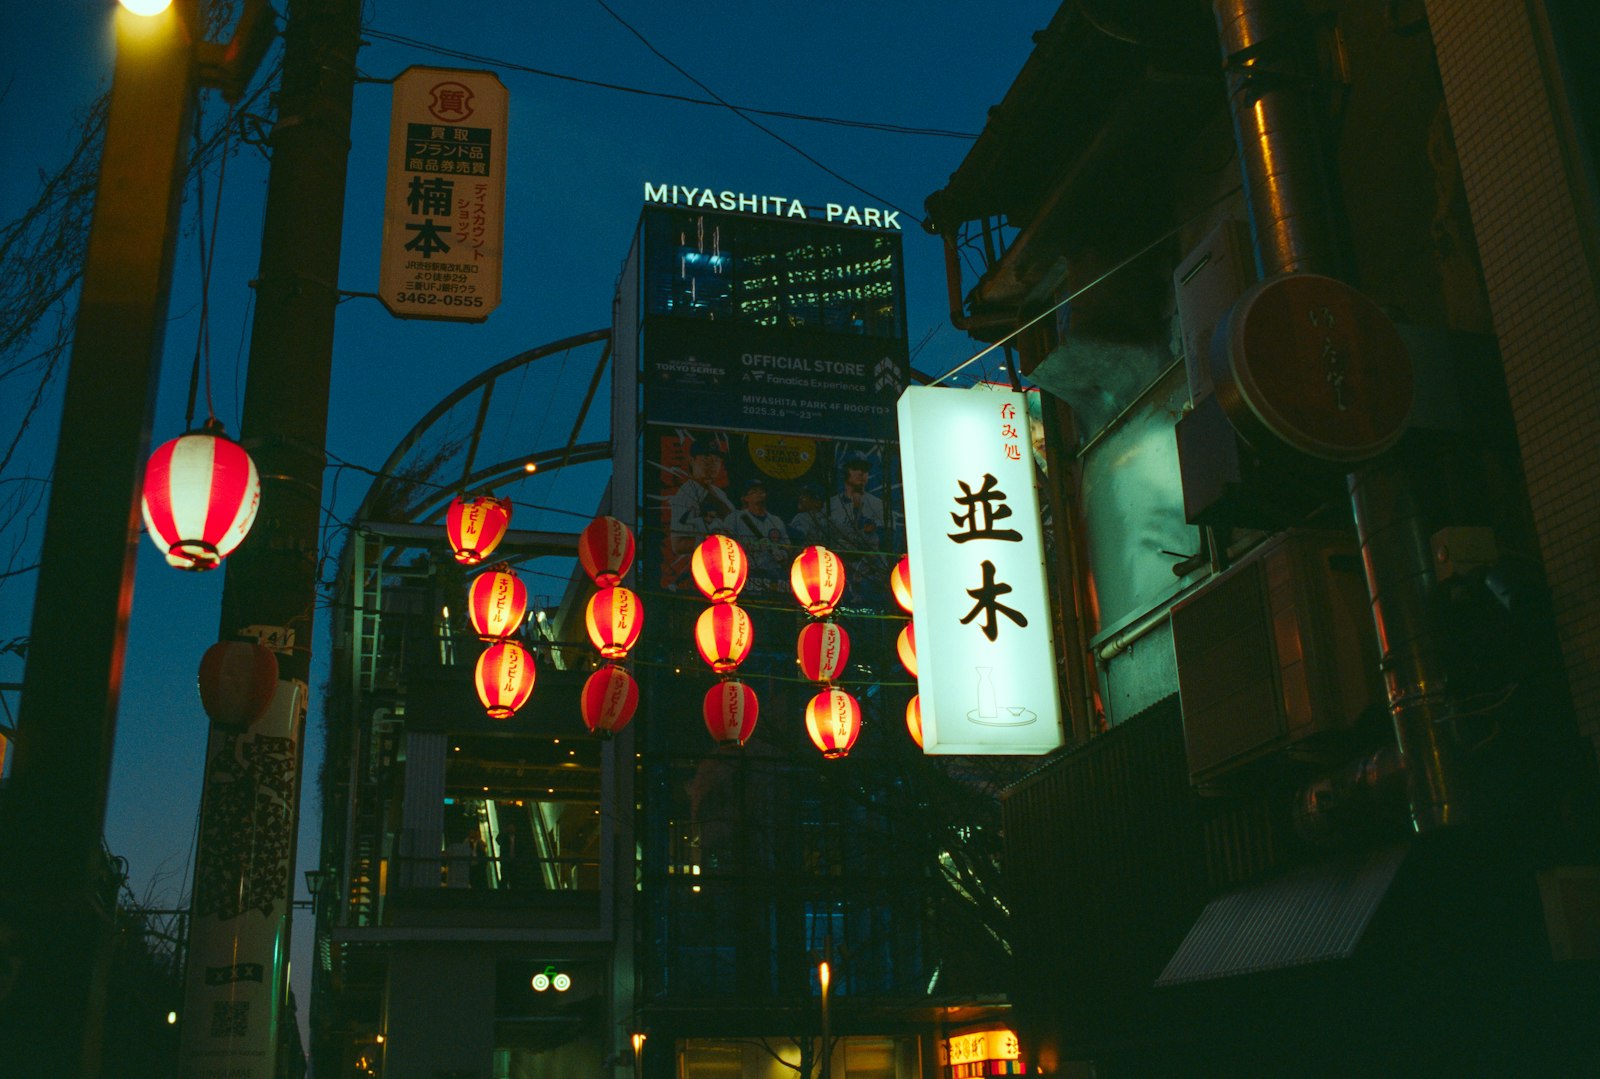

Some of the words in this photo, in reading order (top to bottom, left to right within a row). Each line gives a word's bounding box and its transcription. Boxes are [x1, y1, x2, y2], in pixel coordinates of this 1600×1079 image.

[438, 90, 465, 115] 質
[414, 143, 484, 160] ブランド品
[431, 126, 469, 142] 買取
[409, 158, 487, 175] 商品券売買
[404, 176, 455, 259] 楠本
[456, 199, 471, 244] ショップ
[471, 184, 488, 261] ディスカウント
[644, 181, 807, 220] MIYASHITA
[826, 203, 902, 230] PARK
[396, 291, 483, 308] 3462-0555
[656, 362, 689, 373] TOKYO
[690, 366, 726, 376] SERIES
[741, 353, 812, 372] OFFICIAL
[814, 359, 865, 377] STORE
[766, 373, 809, 387] Fanatics
[810, 379, 866, 393] Experience
[742, 394, 797, 407] MIYASHITA
[800, 400, 827, 410] PARK
[725, 537, 736, 574] キリンビール
[824, 552, 833, 588] キリンビール
[947, 473, 1028, 642] 並木
[493, 578, 508, 623] キリンビール
[618, 590, 628, 629] キリンビール
[735, 606, 746, 647] キリンビール
[823, 629, 836, 671] キリンビール
[503, 648, 518, 692] キリンビール
[728, 685, 738, 728] キリンビール
[836, 695, 847, 737] キリンビール
